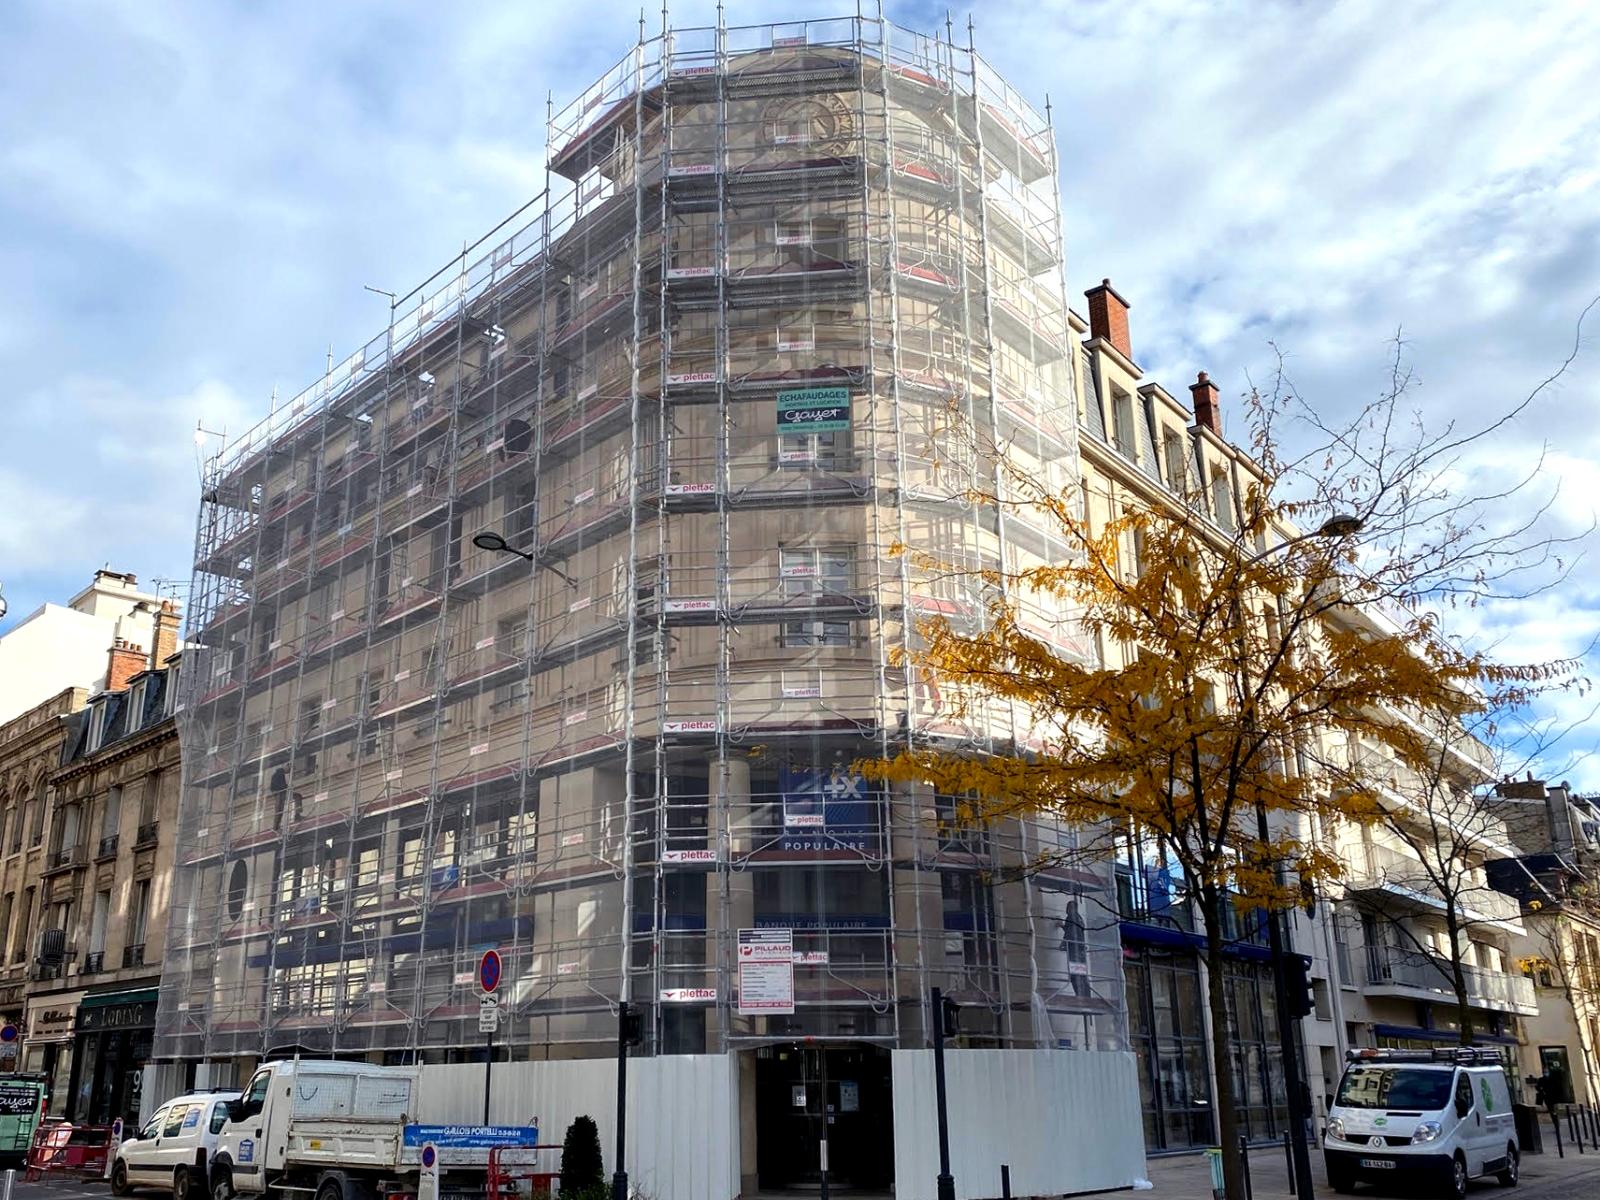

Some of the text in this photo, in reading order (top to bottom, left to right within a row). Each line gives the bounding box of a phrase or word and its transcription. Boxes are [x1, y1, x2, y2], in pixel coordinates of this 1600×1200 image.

[685, 67, 714, 75] plettac
[683, 373, 714, 382] plettac
[780, 390, 847, 402] ECHAFAUDAGES
[682, 483, 714, 492] plettac
[684, 601, 711, 609] plettac
[681, 721, 714, 730] plettac
[797, 815, 823, 824] plettac
[784, 842, 865, 851] POPULAIRE
[681, 850, 715, 860] plettac
[680, 989, 715, 999] plettac
[0, 1097, 36, 1109] ayet
